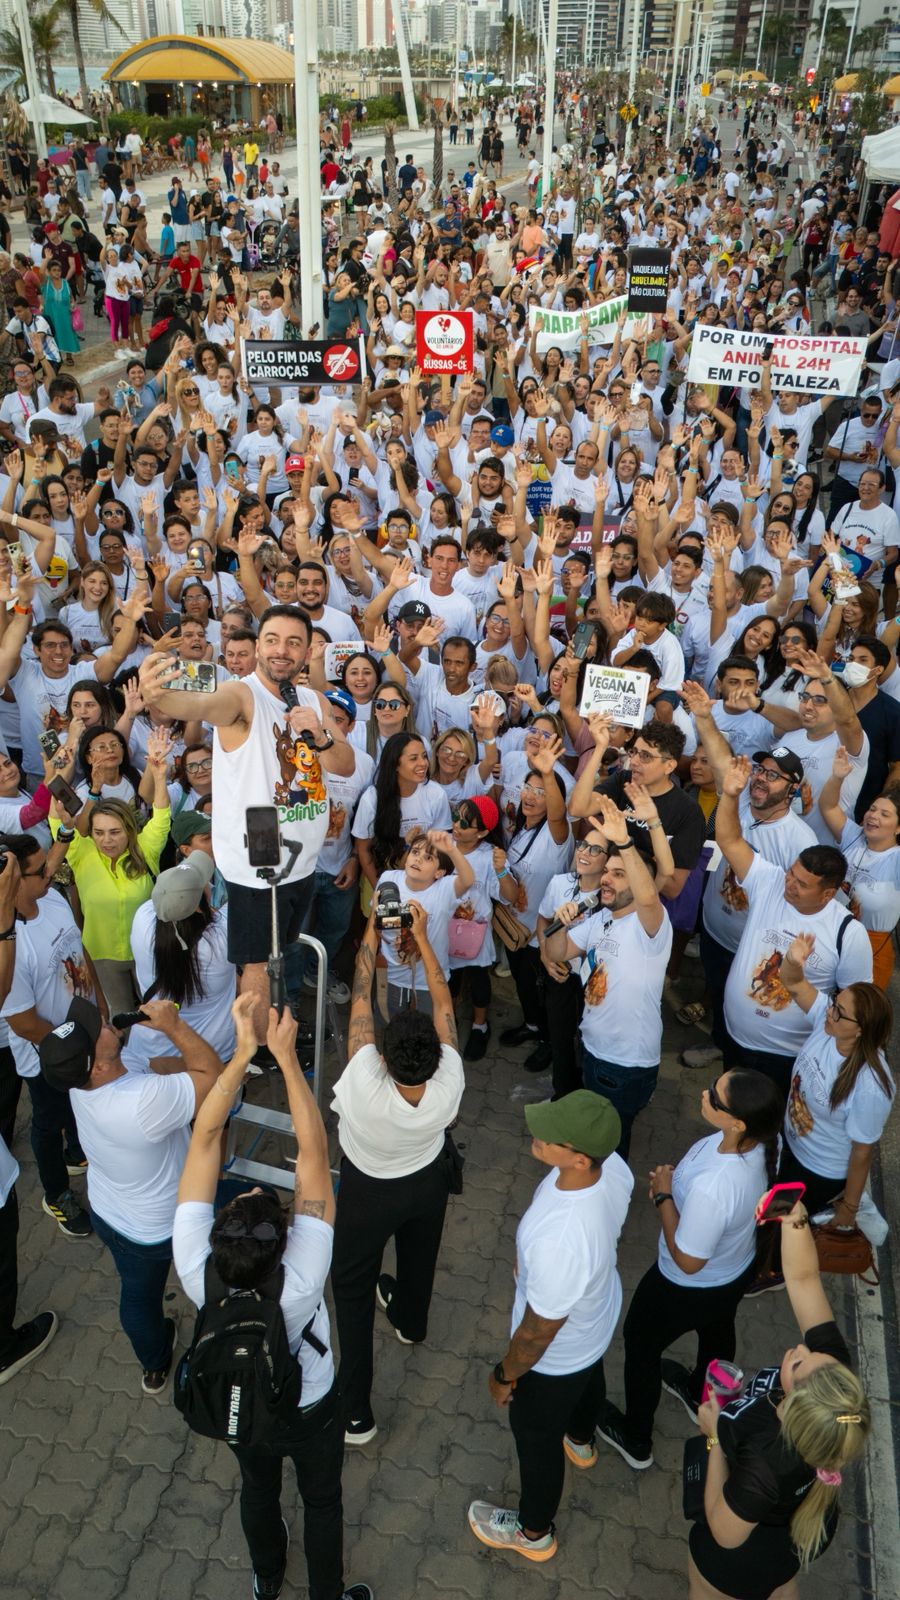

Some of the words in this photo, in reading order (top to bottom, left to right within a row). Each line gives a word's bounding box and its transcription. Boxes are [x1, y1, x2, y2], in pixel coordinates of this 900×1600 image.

[632, 265, 664, 275] VAQUEJADA
[664, 264, 669, 274] É
[631, 276, 668, 287] CRUELDADE,
[630, 287, 642, 296] NÃO
[642, 288, 667, 297] CULTURA.
[699, 329, 735, 346] POR
[740, 334, 768, 348] UM
[773, 337, 862, 355] HOSPITAL
[247, 351, 275, 363] PELO
[277, 351, 298, 363] FIM
[301, 351, 322, 363] DAS
[795, 356, 832, 371] 24H
[248, 365, 309, 379] CARROÇAS
[423, 359, 468, 371] RUSSAS-CE
[707, 366, 732, 381] EM
[737, 369, 841, 391] FOTALEZA
[589, 675, 636, 694] VEGANA
[227, 1385, 242, 1436] mormaii
